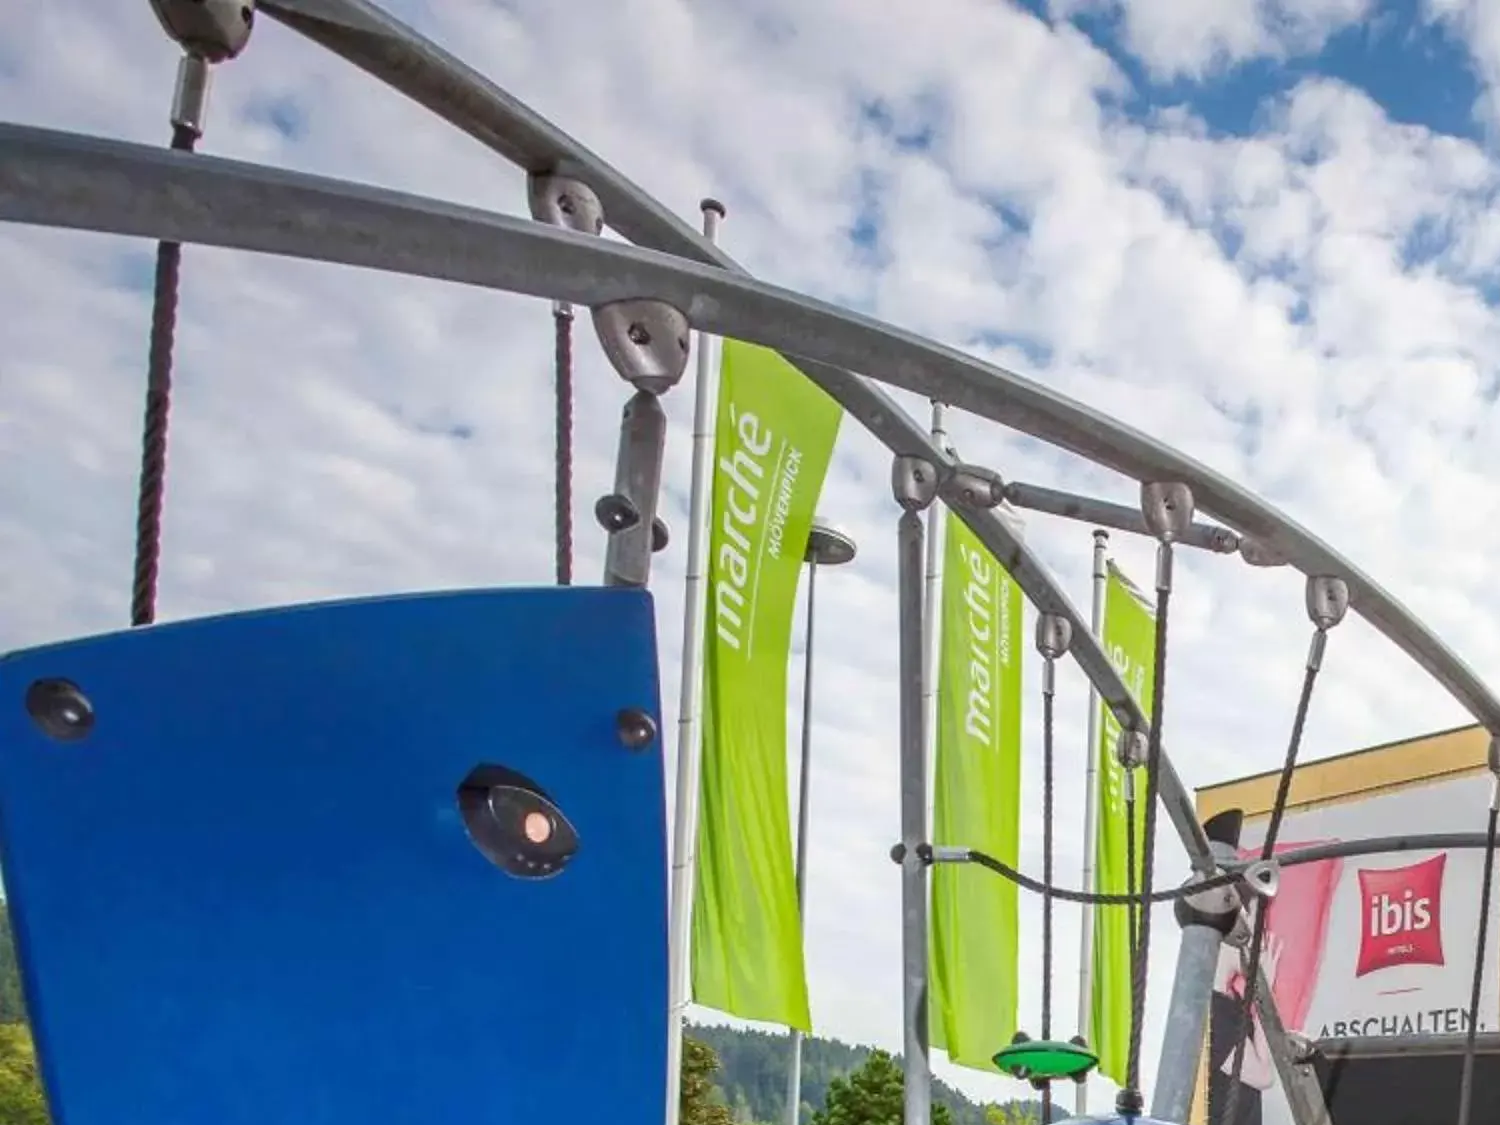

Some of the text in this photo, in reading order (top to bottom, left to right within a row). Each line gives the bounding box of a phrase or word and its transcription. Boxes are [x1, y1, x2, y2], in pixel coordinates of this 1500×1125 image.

[717, 402, 772, 650] marché
[767, 447, 804, 560] MÖVENPICK
[959, 543, 992, 746] marché
[1371, 889, 1432, 937] ibis
